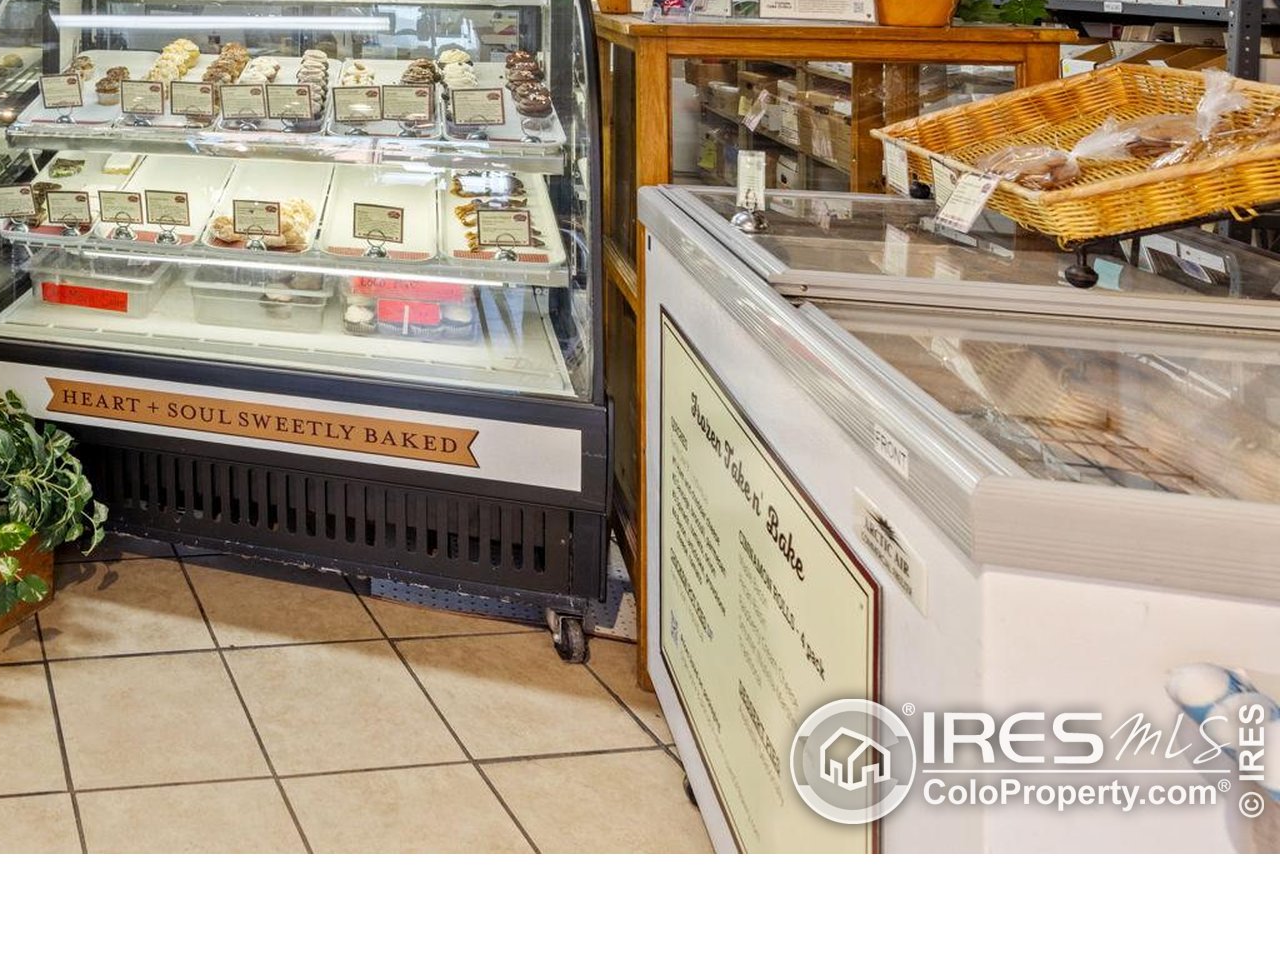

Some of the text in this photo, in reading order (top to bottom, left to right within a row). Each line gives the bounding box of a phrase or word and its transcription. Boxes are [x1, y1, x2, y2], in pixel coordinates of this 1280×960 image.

[62, 389, 141, 413] HEART
[167, 402, 232, 425] SOUL
[238, 411, 357, 441] SWEETLY
[363, 427, 458, 454] BAKED
[875, 429, 907, 474] FRONT
[691, 392, 722, 458] Frozen
[724, 439, 751, 502] Take
[766, 505, 805, 581] Bake
[738, 529, 771, 594] CINNAMON
[772, 584, 796, 631] ROLLS
[893, 551, 911, 578] AIR
